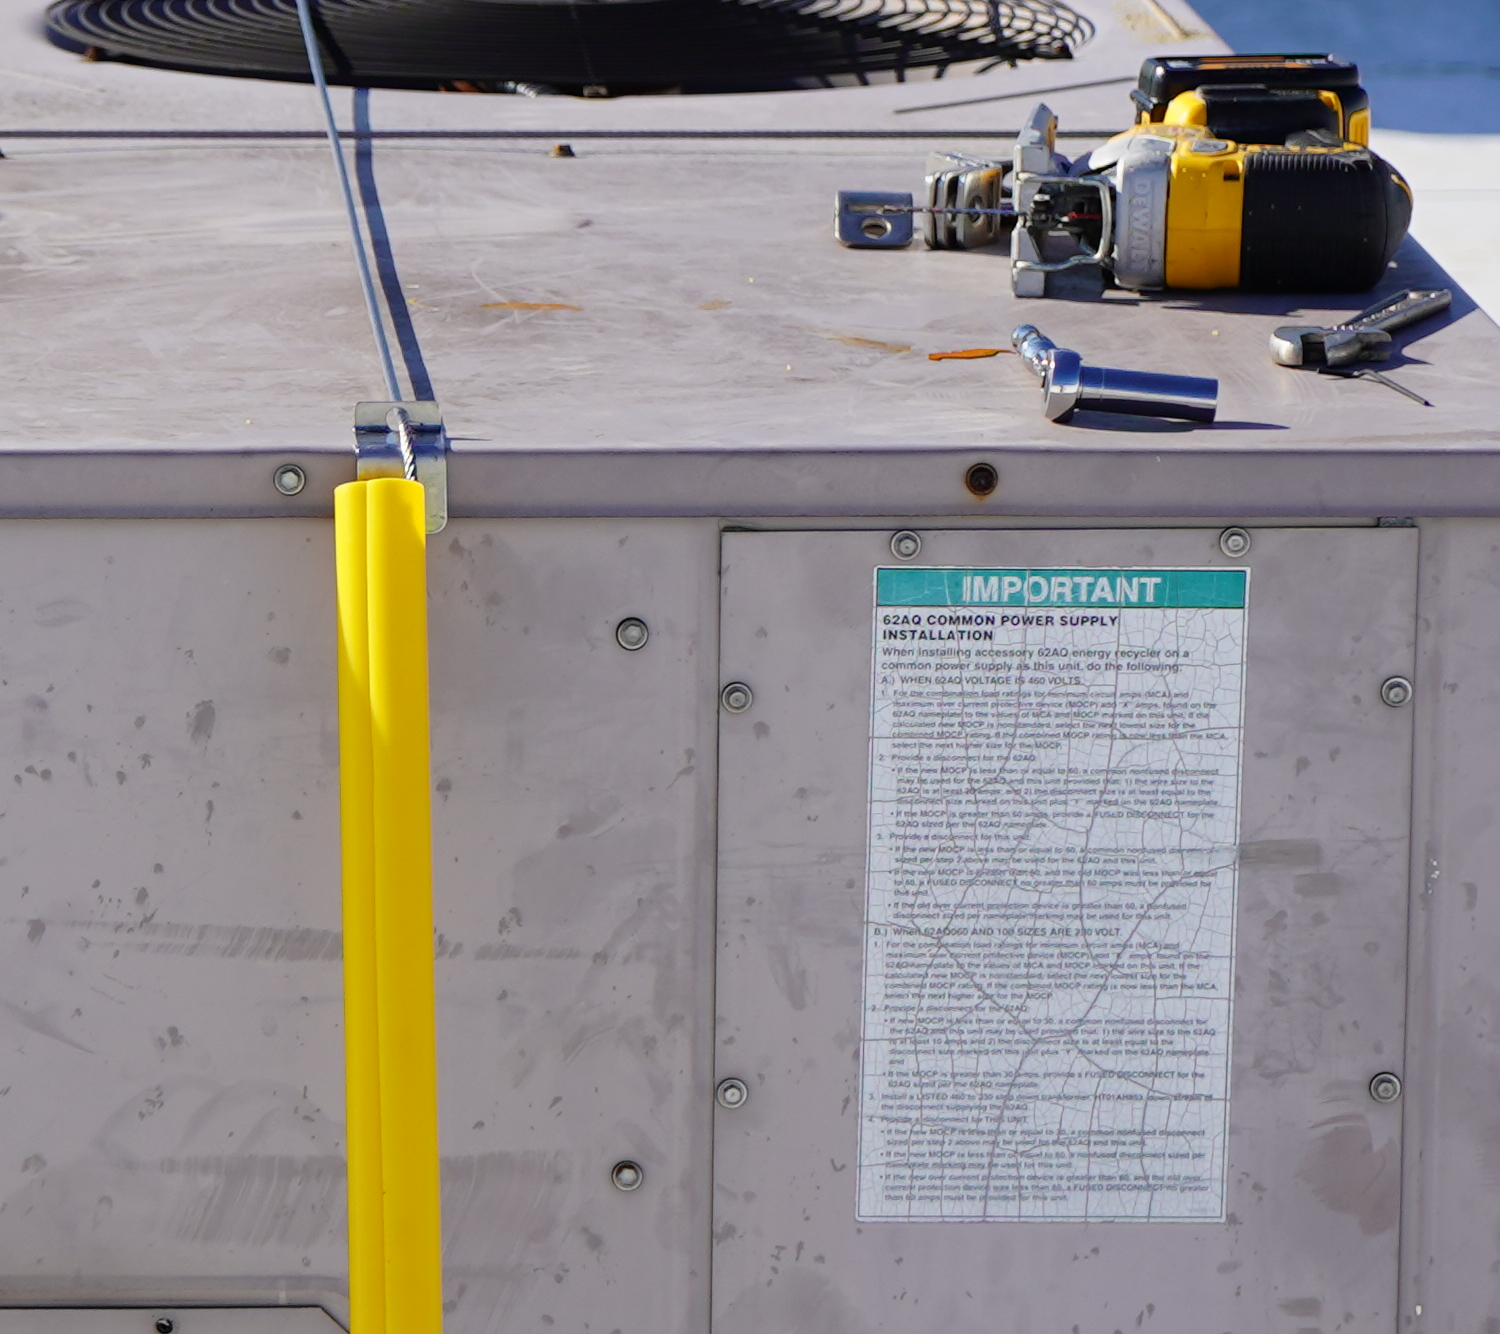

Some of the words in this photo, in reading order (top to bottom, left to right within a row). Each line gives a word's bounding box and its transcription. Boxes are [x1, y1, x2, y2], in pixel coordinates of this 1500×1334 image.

[962, 575, 1162, 603] IMPORTANT
[882, 615, 922, 626] 62AQ
[926, 615, 996, 626] COMMON
[1000, 615, 1055, 626] POWER
[1060, 615, 1119, 626] SUPPLY
[882, 630, 994, 641] INSTALLATION
[882, 647, 914, 657] When
[918, 647, 971, 659] installing
[974, 649, 1034, 659] accessory
[1038, 648, 1069, 657] 62AQ
[1071, 651, 1112, 660] energy
[1115, 648, 1161, 660] recycler
[1165, 650, 1180, 658] on
[881, 662, 931, 670] common
[934, 662, 970, 672] power
[974, 661, 1013, 672] supply
[1032, 661, 1055, 670] this
[1087, 661, 1102, 671] do
[1105, 661, 1123, 671] the
[900, 676, 932, 685] WHEN
[935, 676, 961, 685] 62AQ
[964, 676, 1012, 685] VOLTAGE
[1014, 676, 1025, 685] IS
[1028, 676, 1046, 685] 460
[970, 928, 994, 937] AND
[1016, 928, 1048, 937] SIZES
[1050, 928, 1072, 937] ARE
